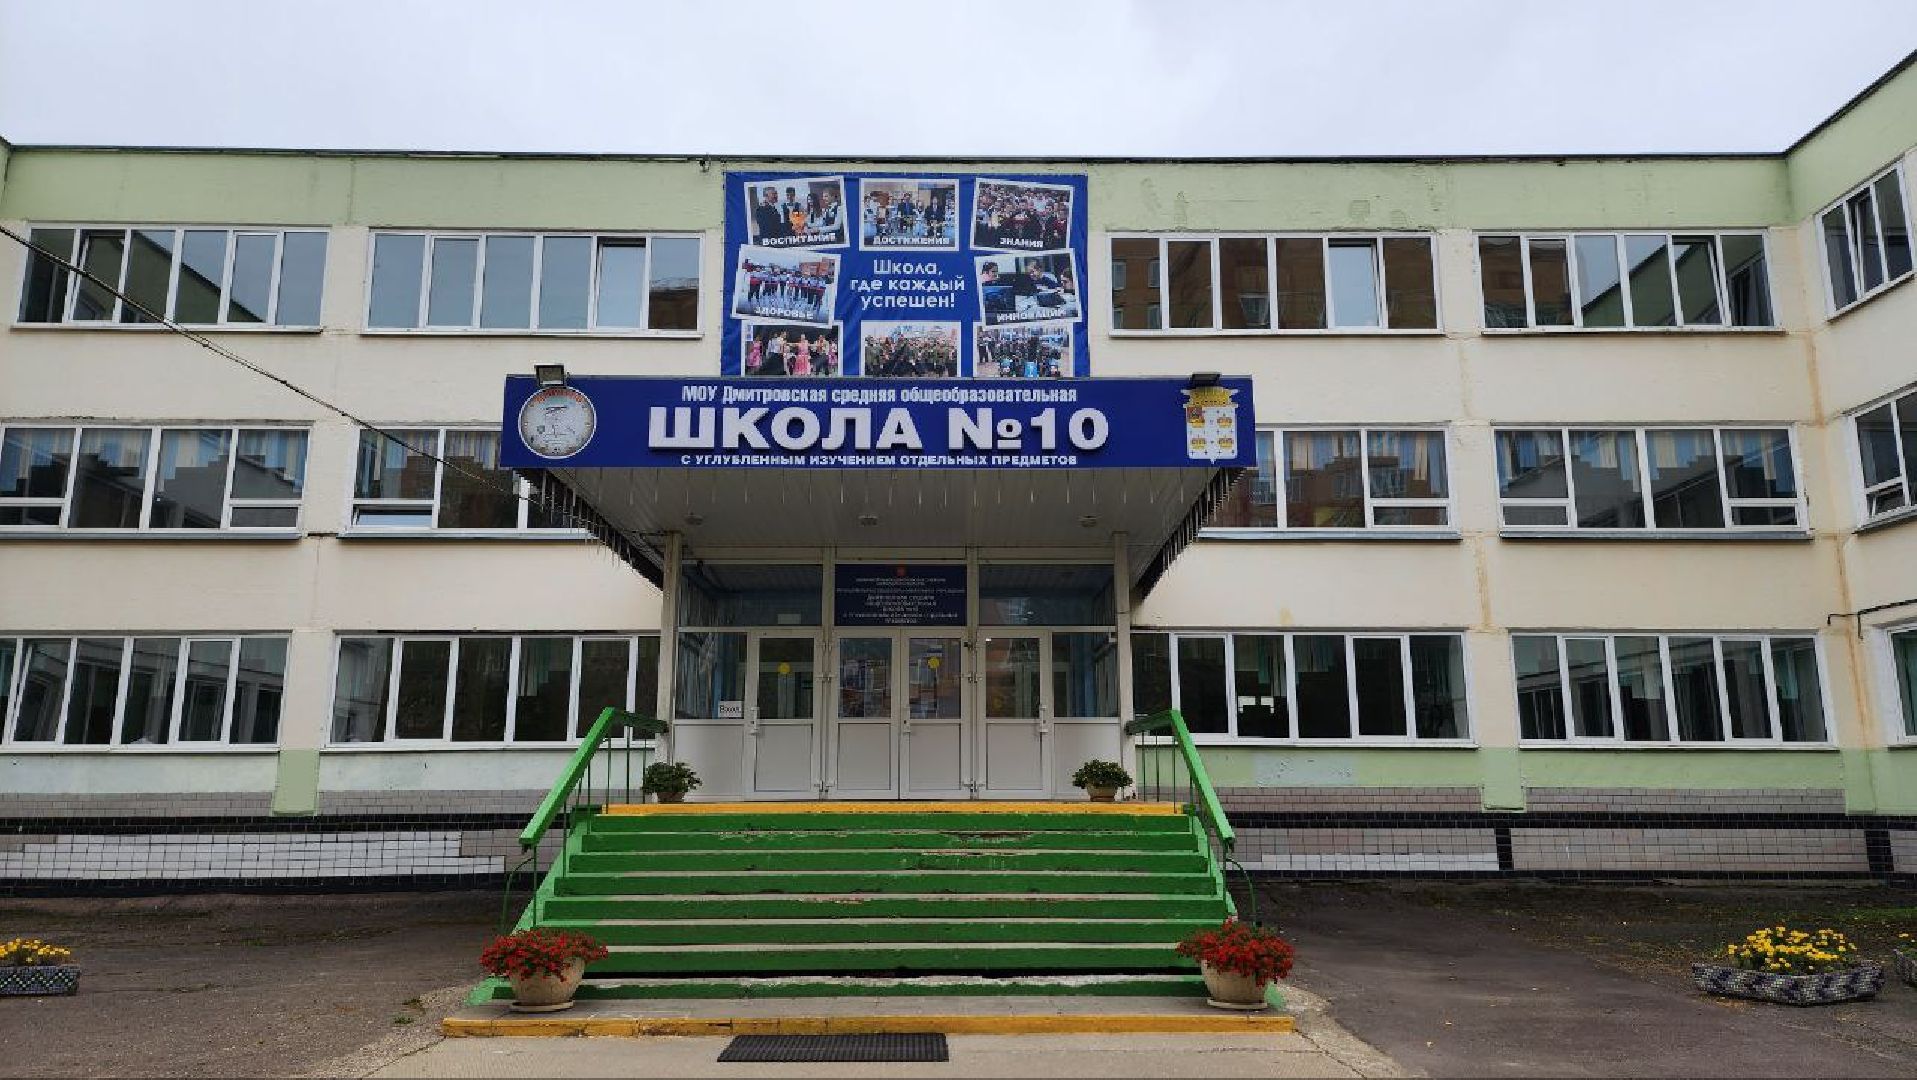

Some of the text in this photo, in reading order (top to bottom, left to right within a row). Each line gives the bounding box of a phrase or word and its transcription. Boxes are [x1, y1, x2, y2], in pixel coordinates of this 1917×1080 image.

[873, 236, 950, 245] ДОСТИЖЕНИЯ
[1000, 237, 1044, 248] ЗНАНИЯ
[873, 259, 942, 275] Школа,
[850, 275, 965, 292] где каждый
[861, 292, 955, 310] успешен!
[755, 306, 814, 320] ЗДОРОВЬЕ
[681, 385, 1077, 405] МОУ Дмитровская средняя общеобразовательная
[648, 406, 1109, 450] ШКОЛА №10
[696, 455, 806, 465] УГЛУБЛЕННЫМ
[809, 455, 896, 465] ИЗУЧЕНИЕМ
[900, 455, 987, 467] ОТДЕЛЬНЫХ
[991, 455, 1077, 467] ПРЕДМЕТОВ
